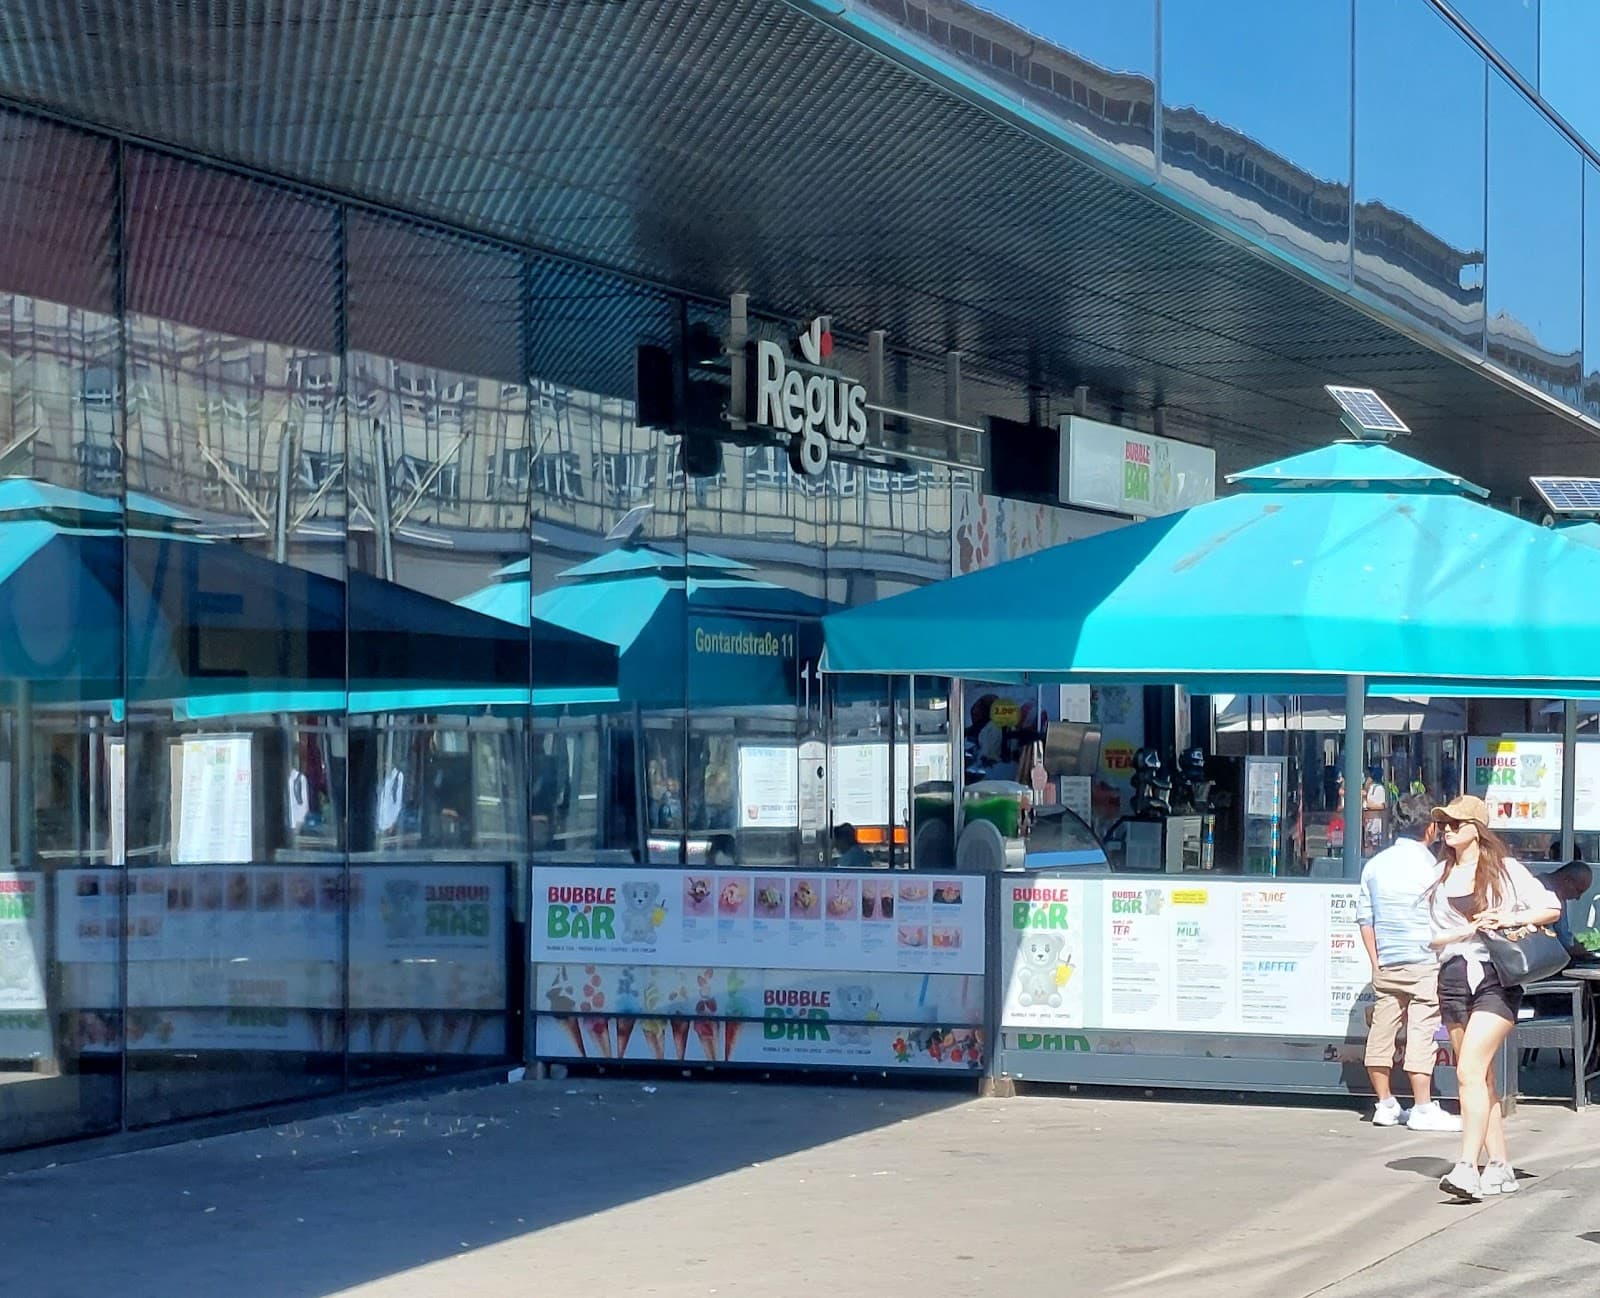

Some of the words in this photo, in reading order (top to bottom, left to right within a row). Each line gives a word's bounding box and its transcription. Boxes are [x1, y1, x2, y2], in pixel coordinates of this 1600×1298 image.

[757, 340, 867, 475] Regus
[1125, 441, 1150, 464] BUBBLE
[695, 627, 779, 656] Gontardstraße
[782, 633, 793, 657] 11
[1475, 757, 1517, 767] BUBBLE
[548, 886, 616, 904] BUBBLE
[1012, 887, 1069, 902] BUBBLE
[764, 990, 831, 1008] BUBBLE
